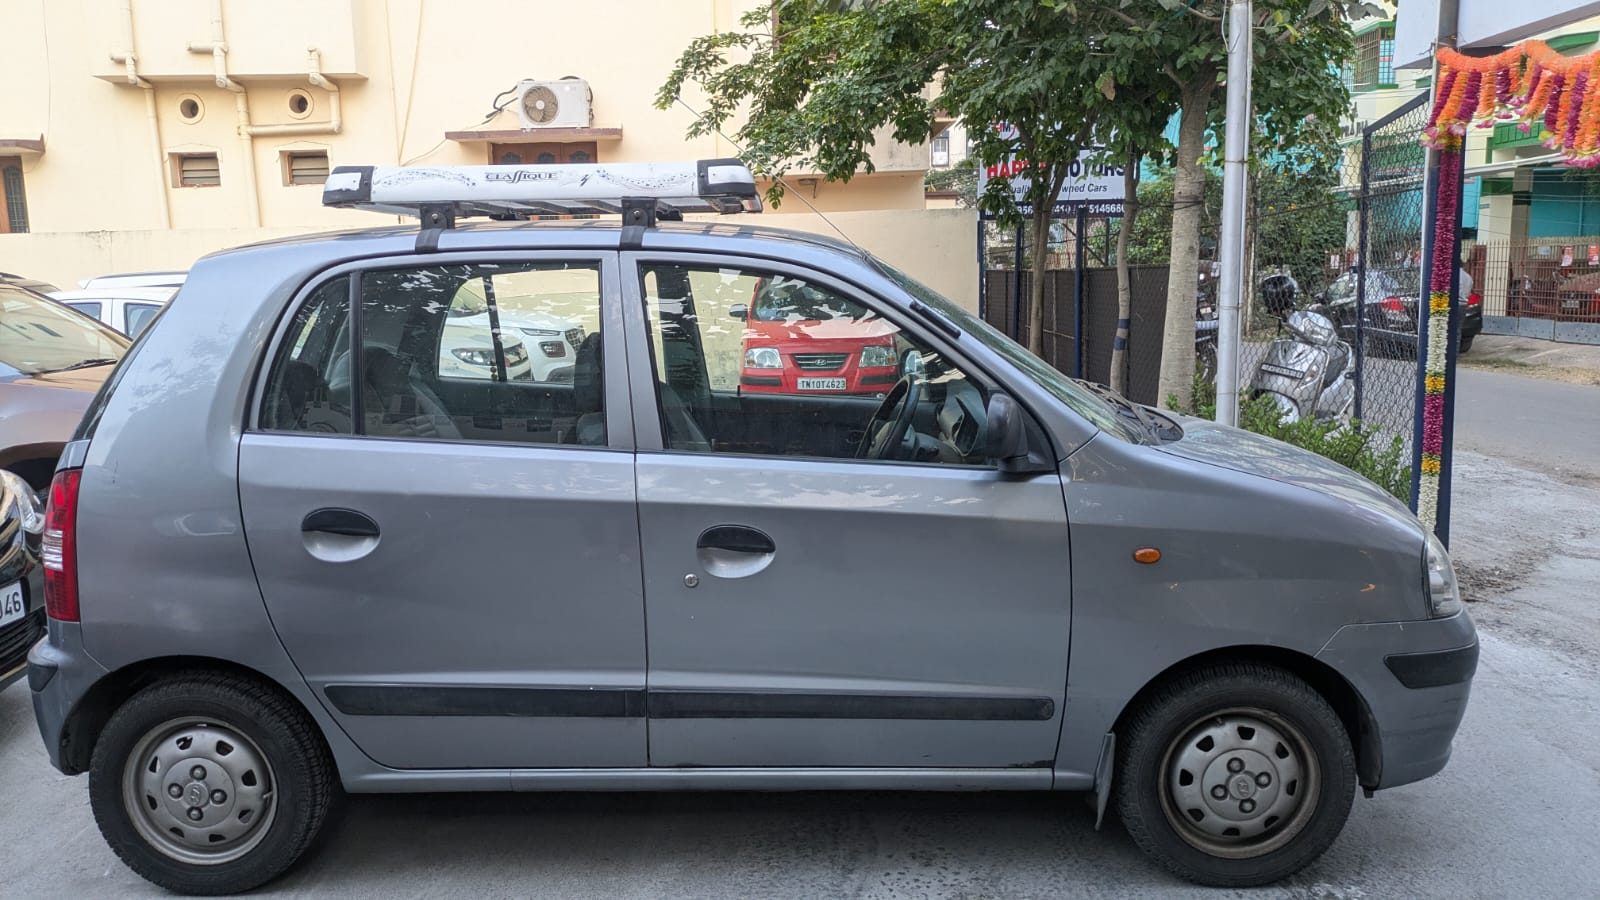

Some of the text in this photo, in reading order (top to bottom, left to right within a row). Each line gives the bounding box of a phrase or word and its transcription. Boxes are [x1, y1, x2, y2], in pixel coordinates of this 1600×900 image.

[1061, 158, 1126, 178] OORS
[485, 170, 558, 184] CLASSIQUE
[1062, 183, 1086, 193] wned
[1087, 183, 1108, 193] Cars
